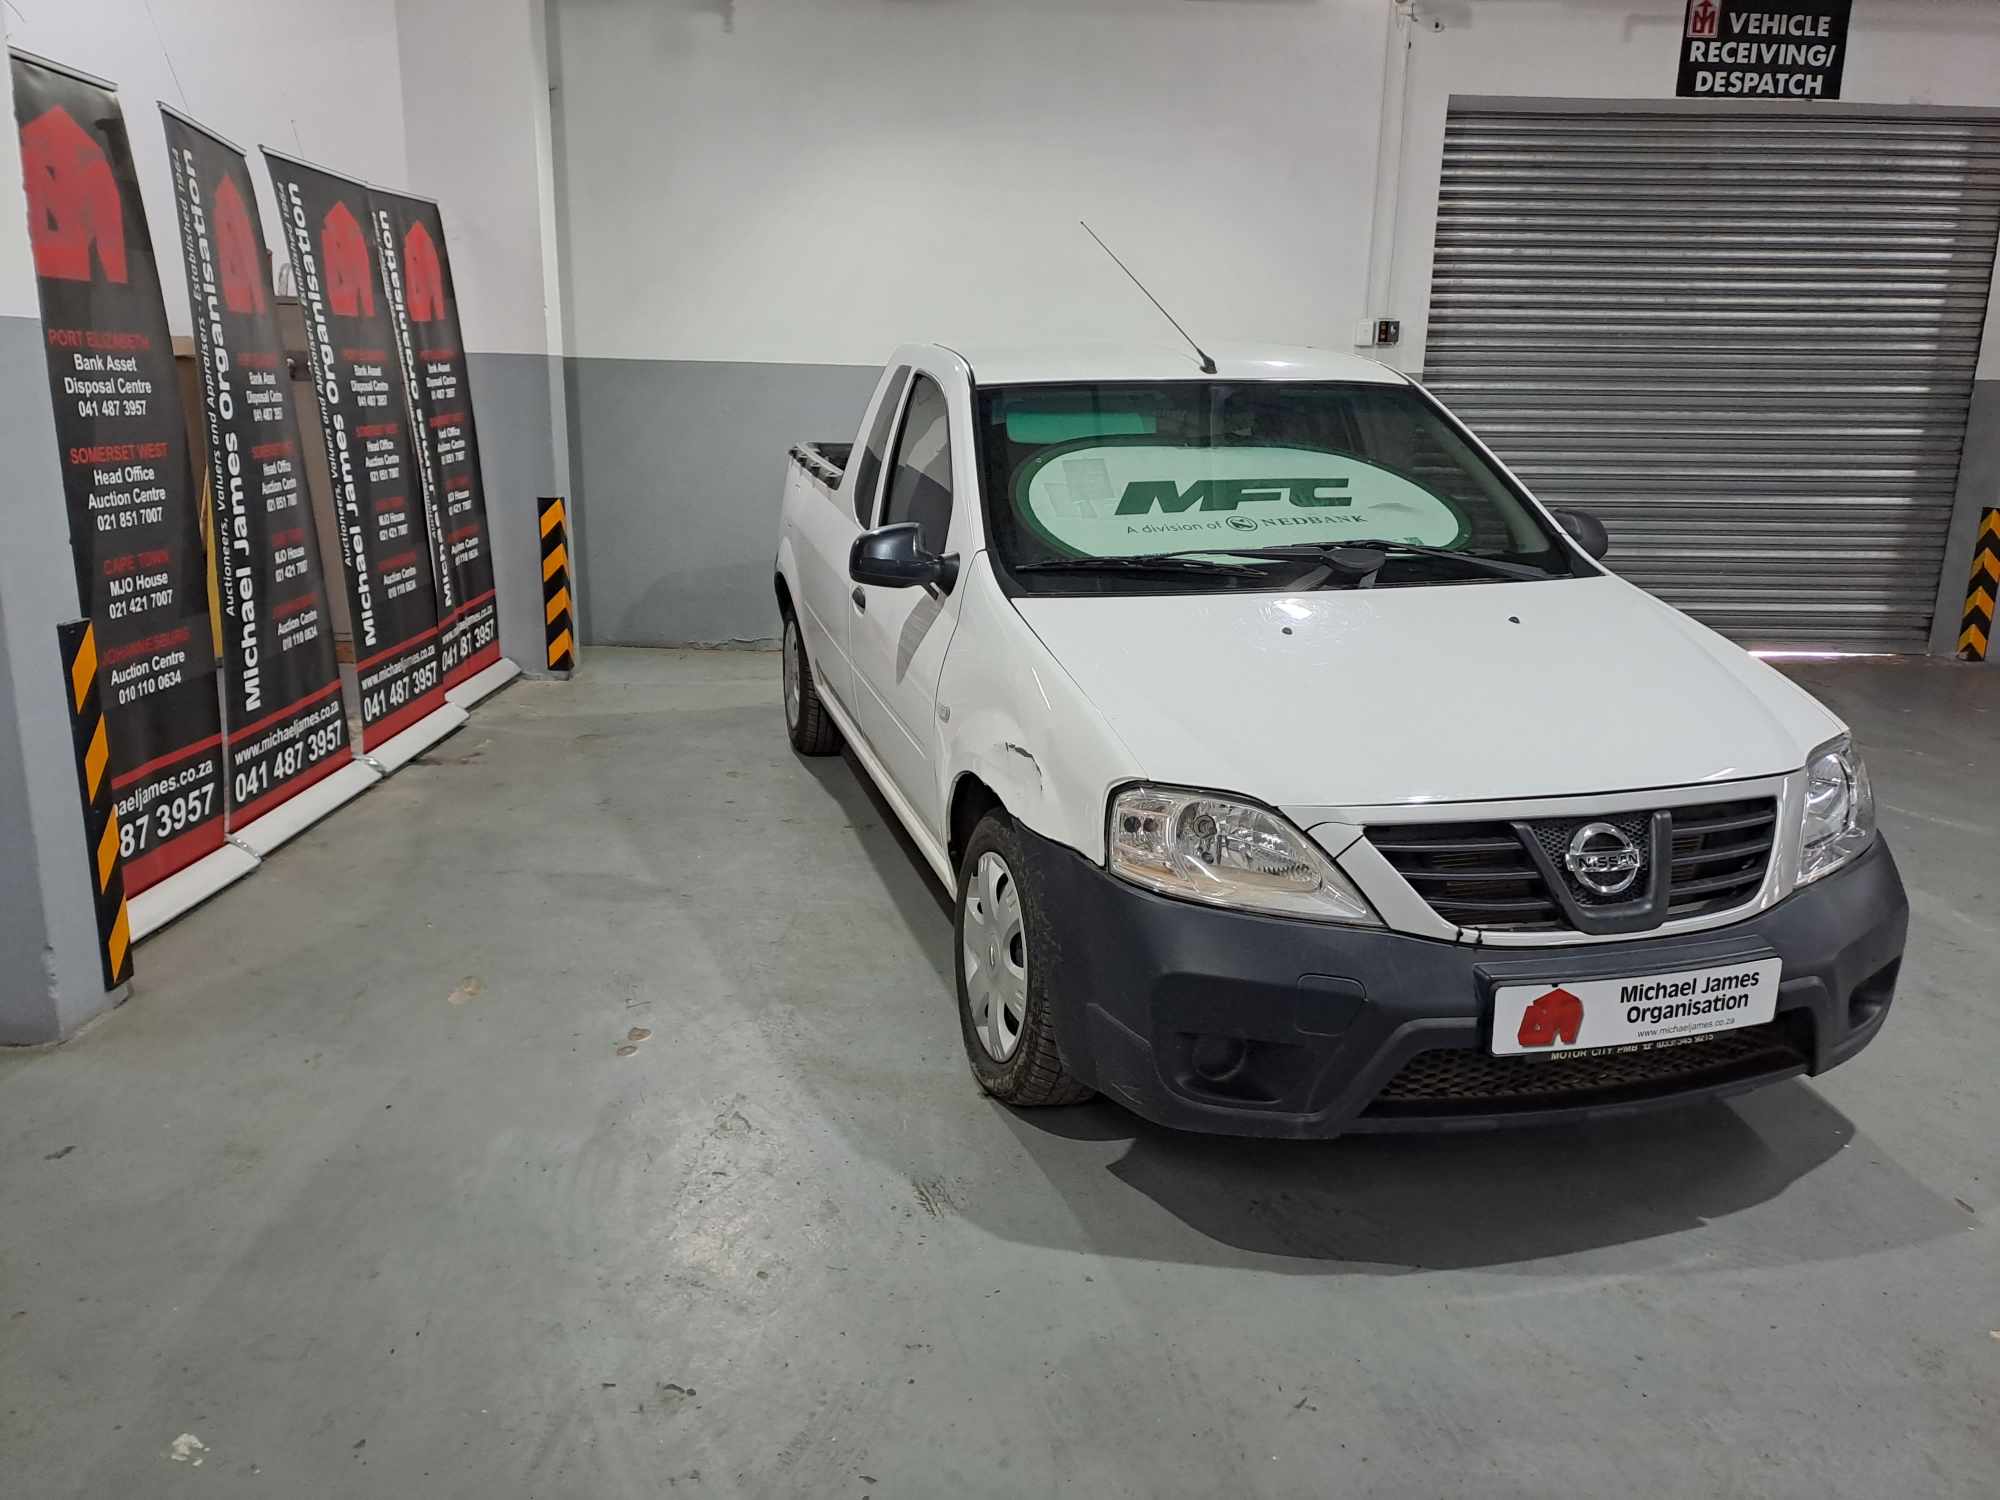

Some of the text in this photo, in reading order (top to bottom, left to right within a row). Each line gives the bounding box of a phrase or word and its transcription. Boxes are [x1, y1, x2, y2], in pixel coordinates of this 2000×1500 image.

[1729, 12, 1832, 37] VEHICLE
[1689, 41, 1837, 67] RECEIVING/
[1694, 71, 1824, 95] DESPATCH
[73, 353, 137, 371] Bank Asset
[199, 317, 216, 408] Appraisers
[64, 377, 151, 397] Disposal Centre
[78, 400, 147, 417] 041 487 3957
[288, 182, 377, 647] Michael James Organisation
[183, 149, 262, 712] Michael James Organisation
[207, 411, 219, 446] and
[70, 444, 135, 464] SOMERSET
[93, 465, 155, 486] Head Office
[213, 449, 226, 511] Valuers
[88, 487, 166, 510] Auction Centre
[1114, 478, 1352, 515] MFC
[97, 507, 163, 531] 021 851 7007
[1127, 514, 1368, 534] A division of NEDBANK
[109, 572, 168, 597] MJO House
[109, 590, 173, 619] 021 421 7007
[441, 643, 458, 671] 041
[474, 618, 494, 648] 3957
[111, 650, 185, 686] Auction Centre
[118, 686, 136, 705] 010
[137, 678, 155, 695] 110
[363, 661, 438, 722] 041 487 3957
[234, 701, 339, 766] www.michaeljames.co.za
[235, 720, 341, 802] 041 487 3957
[155, 783, 215, 838] 3957
[1620, 972, 1760, 1003] Michael James
[1627, 993, 1749, 1023] Organisation
